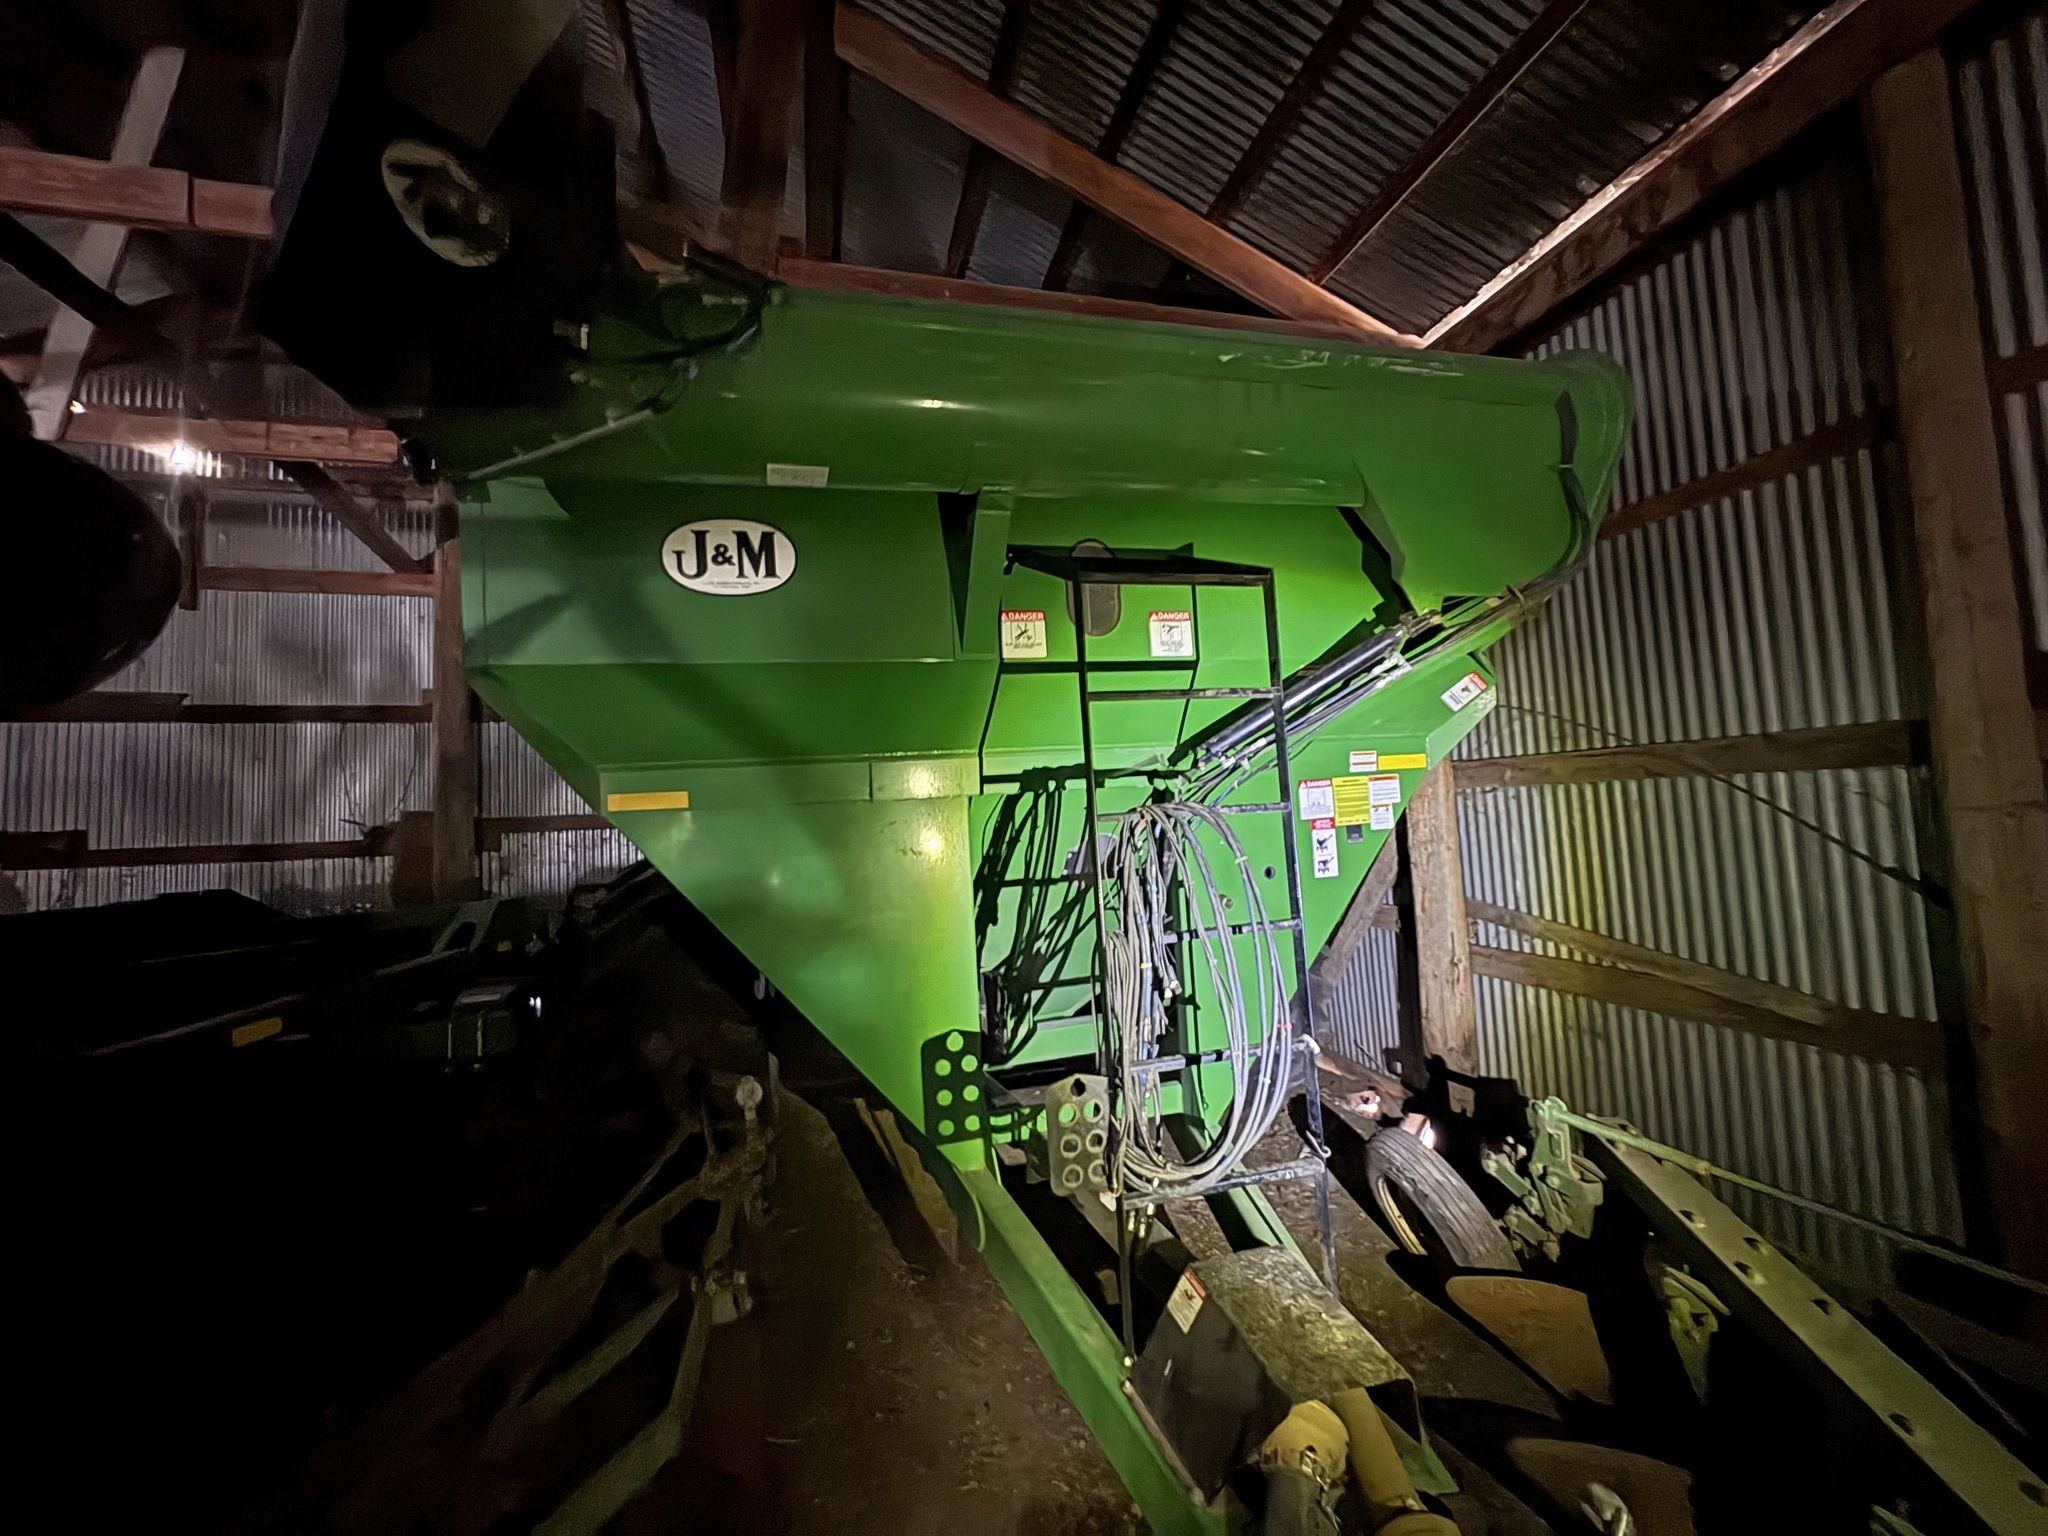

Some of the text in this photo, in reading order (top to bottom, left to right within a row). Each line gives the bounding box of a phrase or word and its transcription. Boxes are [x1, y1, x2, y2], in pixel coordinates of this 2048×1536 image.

[671, 529, 781, 580] J&M
[1008, 612, 1044, 621] DANGER
[1157, 611, 1190, 621] DANGER
